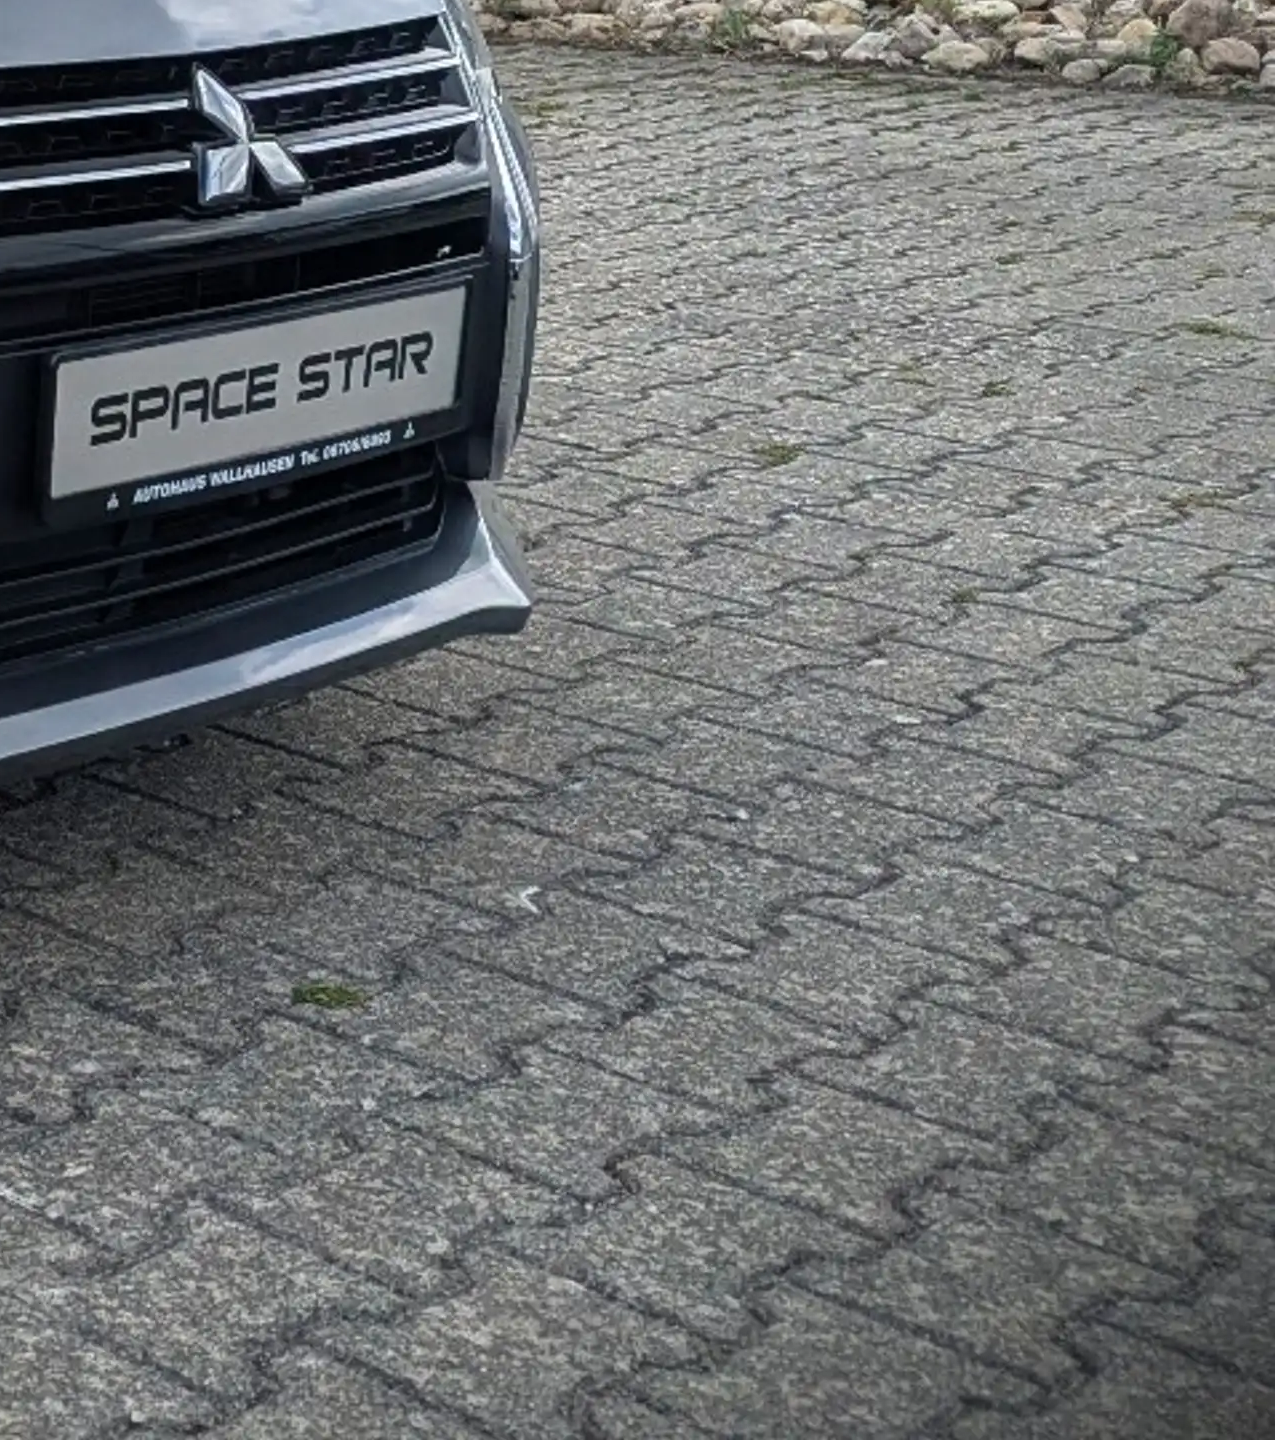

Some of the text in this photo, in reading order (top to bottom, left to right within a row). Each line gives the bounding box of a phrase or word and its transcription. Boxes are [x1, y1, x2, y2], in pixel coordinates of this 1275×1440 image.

[90, 331, 433, 446] SPACE STAR
[132, 474, 208, 505] AUTOHAUS
[209, 454, 296, 488] WALLHAUSEN
